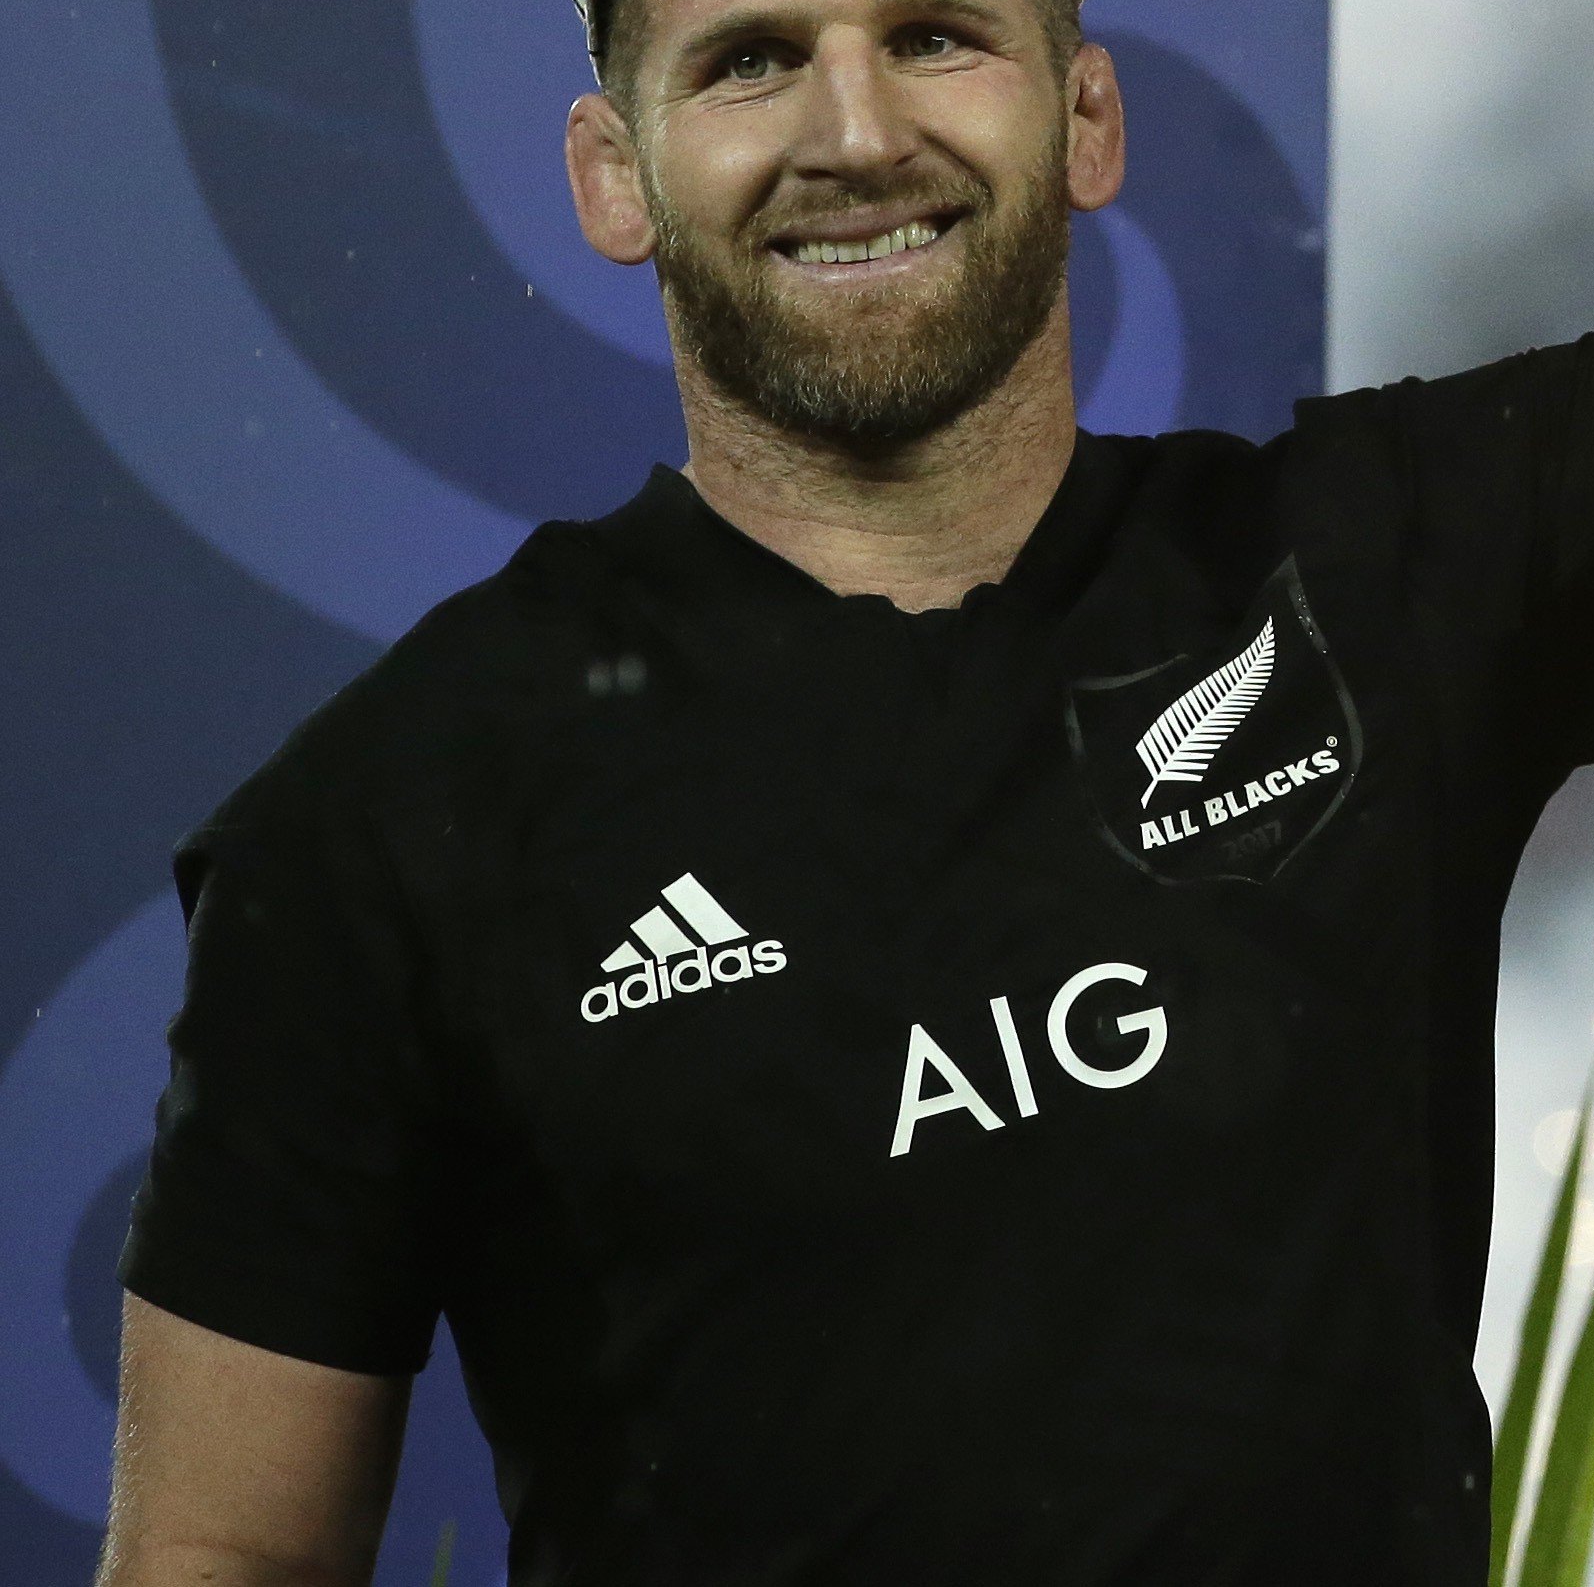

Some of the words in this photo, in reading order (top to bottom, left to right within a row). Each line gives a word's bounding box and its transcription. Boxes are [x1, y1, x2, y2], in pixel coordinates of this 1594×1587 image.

[1139, 809, 1200, 850] ALL
[1203, 749, 1340, 826] BLACKS
[580, 940, 788, 1023] adidas
[890, 962, 1168, 1158] AIG
